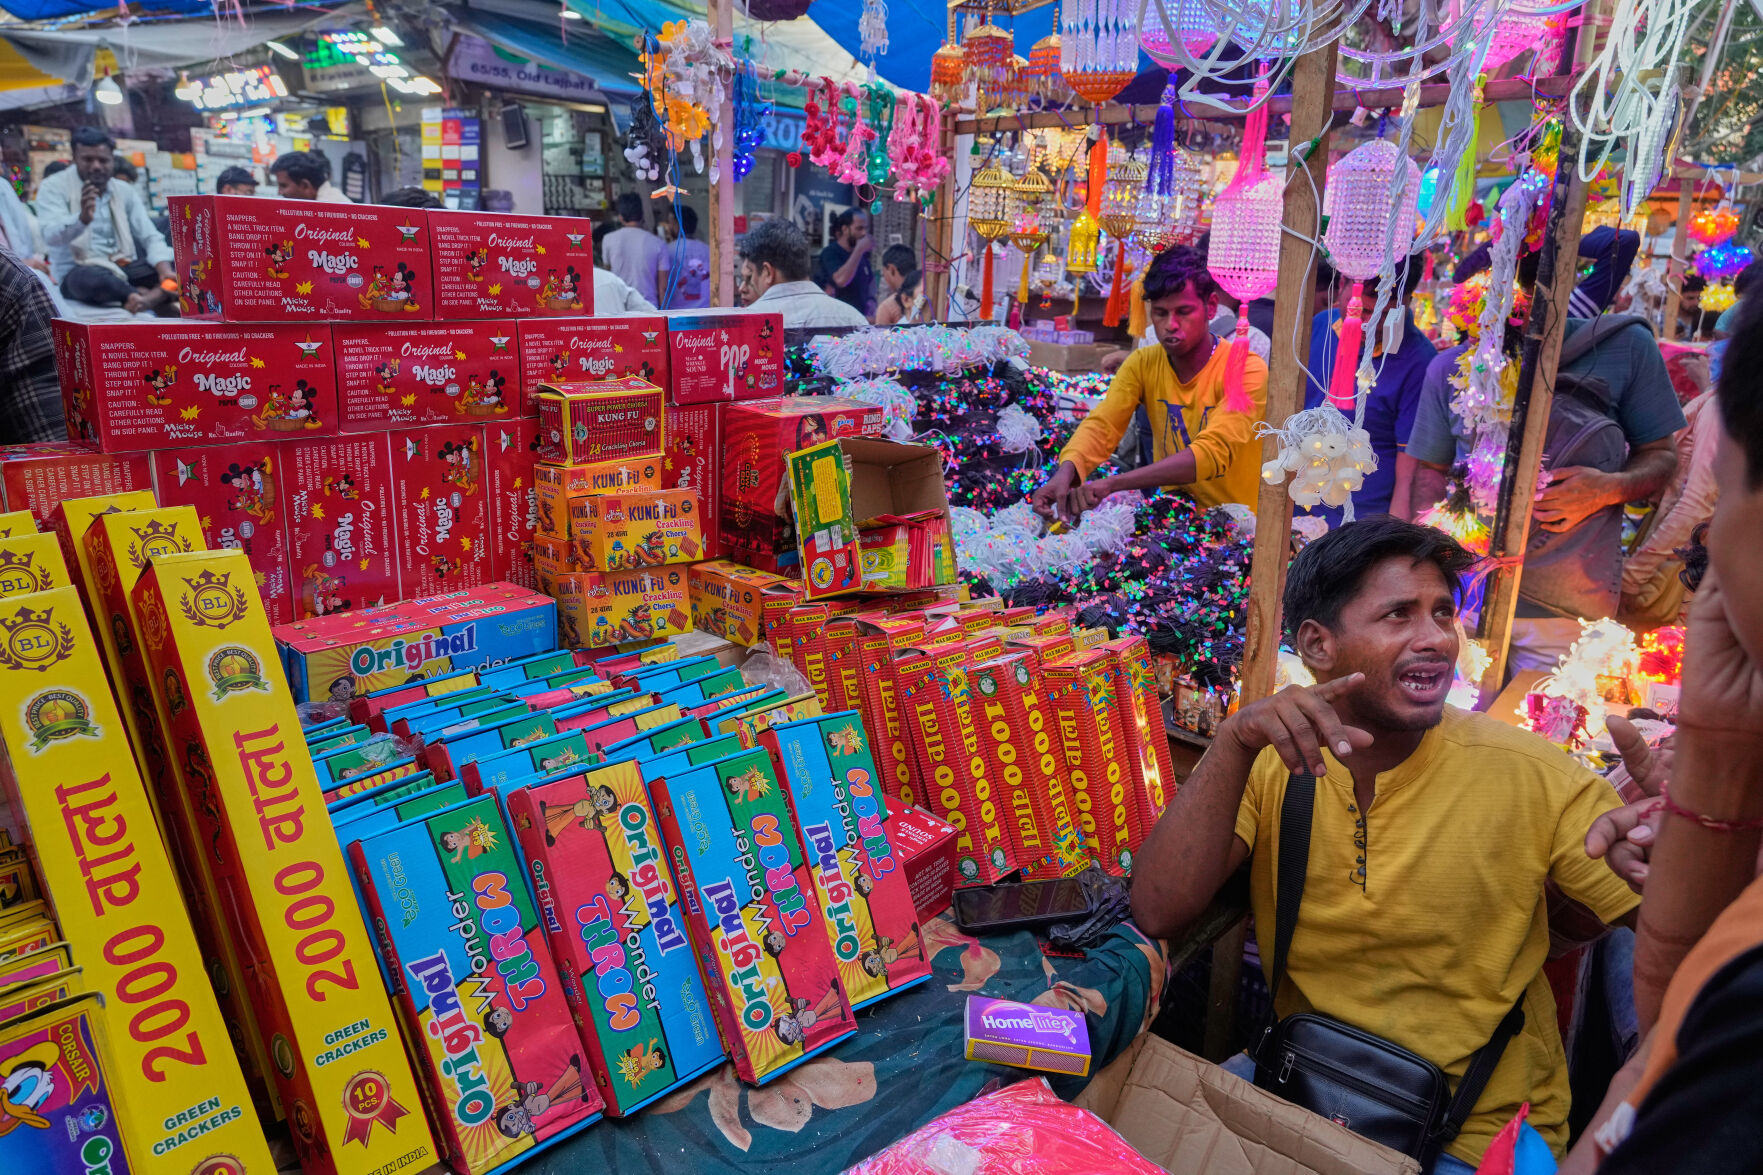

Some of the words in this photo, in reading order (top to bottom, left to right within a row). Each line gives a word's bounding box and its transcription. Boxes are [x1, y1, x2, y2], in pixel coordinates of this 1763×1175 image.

[517, 70, 540, 82] Old
[294, 224, 354, 245] Original
[488, 233, 534, 252] Original
[308, 250, 358, 274] Magic
[498, 256, 537, 277] Magic
[233, 280, 264, 288] CAREFULLY
[281, 297, 308, 305] Micky
[286, 304, 315, 312] Mouse
[401, 341, 453, 361] Original
[570, 336, 612, 353] Original
[676, 332, 716, 353] Original
[178, 346, 247, 368] Original
[579, 356, 615, 375] Magic
[105, 380, 122, 388] STEP
[193, 372, 251, 396] Magic
[412, 364, 456, 386] Magic
[109, 410, 144, 418] CAREFULLY
[133, 417, 165, 425] CAUTIONS
[387, 408, 412, 416] Micky
[390, 415, 417, 423] Mouse
[598, 412, 625, 422] KUNG
[627, 411, 640, 420] FU
[863, 414, 881, 424] RING
[163, 423, 196, 432] Micky
[169, 430, 203, 440] Mouse
[862, 424, 882, 434] CAPS
[589, 444, 601, 455] 28
[601, 443, 628, 452] Crackling
[435, 497, 453, 543] Magic
[506, 492, 521, 541] Original
[525, 487, 539, 530] Magic
[629, 505, 660, 521] KUNG
[358, 500, 378, 555] Original
[414, 503, 429, 556] Original
[656, 519, 694, 529] Crackling
[334, 512, 355, 561] Magic
[0, 576, 30, 592] BL
[613, 578, 646, 596] KUNG
[642, 590, 683, 602] Crackling
[704, 581, 727, 598] KUNG
[200, 597, 228, 611] BL
[18, 636, 51, 652] BL
[351, 622, 478, 676] Original
[906, 634, 921, 642] BRAND
[1083, 632, 1105, 646] KUNG
[913, 662, 930, 670] BRAND
[66, 696, 84, 717] QUALITY
[915, 702, 946, 764] वाला
[1022, 691, 1056, 776] 1000
[1057, 708, 1083, 766] वाला
[984, 700, 1023, 786] 1000
[1012, 787, 1042, 848] वाला
[232, 722, 305, 851] वाला
[934, 765, 973, 852] 1000
[970, 756, 1001, 845] 1000
[1106, 761, 1129, 845] 1000
[830, 777, 864, 876] Wonder
[846, 766, 896, 881] THROW
[898, 821, 934, 840] SOUND
[54, 772, 142, 918] वाला
[618, 802, 687, 956] Original
[673, 845, 701, 915] Original
[731, 826, 774, 936] Wonder
[750, 813, 812, 937] THROW
[532, 860, 562, 934] Original
[803, 820, 861, 962] Original
[273, 861, 359, 1003] 2000
[471, 870, 546, 1011] THROW
[375, 916, 406, 995] Original
[446, 891, 500, 1014] Wonder
[576, 895, 641, 1033] THROW
[617, 895, 662, 1011] Wonder
[701, 877, 773, 1032] Original
[102, 924, 208, 1082] 2000
[324, 1018, 371, 1045] GREEN
[406, 949, 496, 1127] Original
[58, 1023, 91, 1083] CORSAIR
[314, 1028, 388, 1068] CRACKERS
[354, 1082, 377, 1098] 10
[163, 1096, 221, 1131] GREEN
[151, 1105, 243, 1156] CRACKERS
[382, 1161, 397, 1175] IN
[397, 1146, 429, 1168] INDIA
